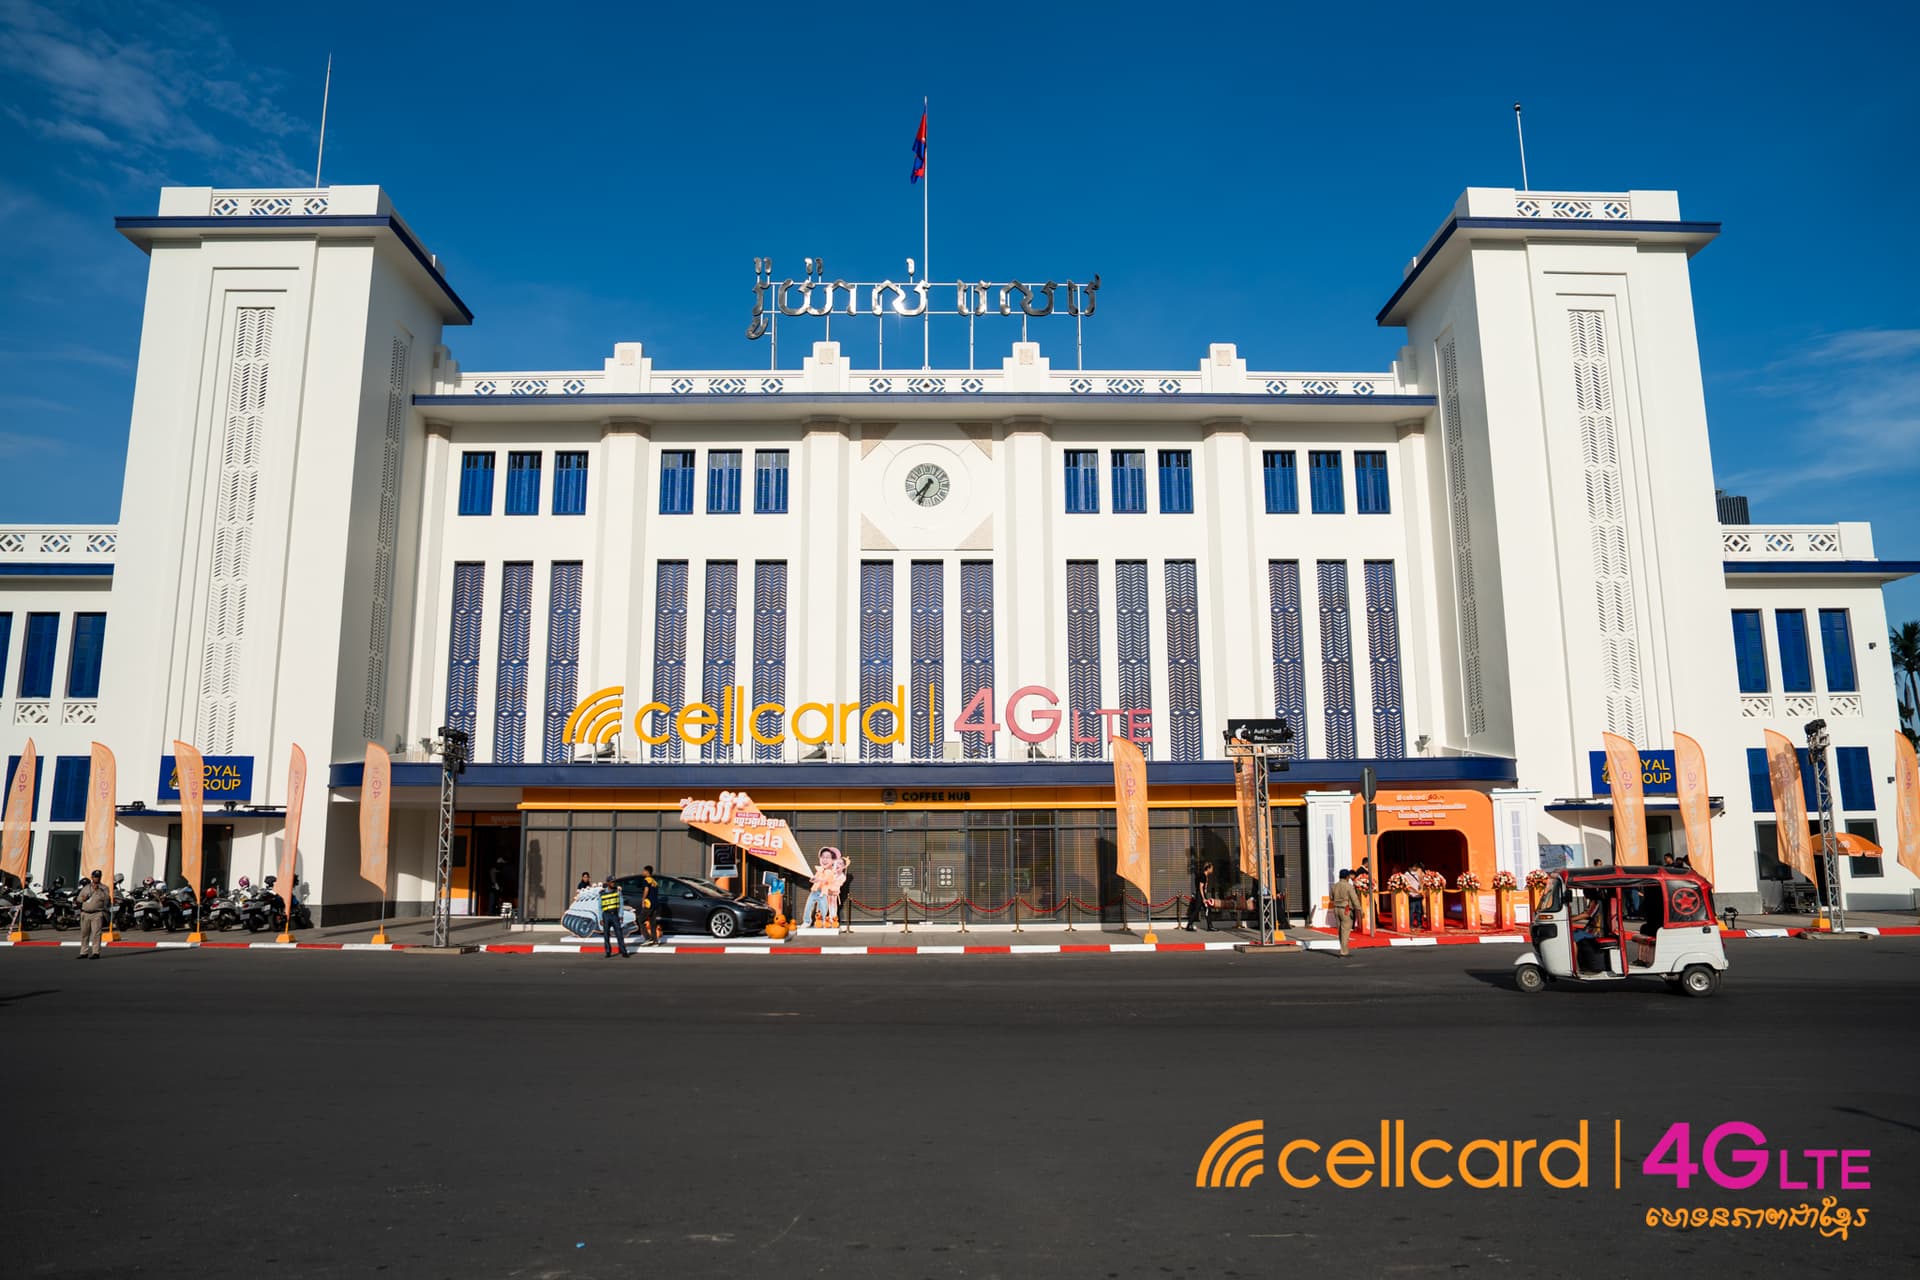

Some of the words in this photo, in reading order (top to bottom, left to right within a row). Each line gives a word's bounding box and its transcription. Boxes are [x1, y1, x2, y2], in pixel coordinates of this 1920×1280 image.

[633, 685, 905, 745] cellcard
[954, 685, 1062, 745] 4G
[1072, 708, 1153, 745] LTE
[203, 765, 241, 777] OYAL
[203, 778, 241, 790] ROUP
[902, 791, 945, 801] COFFEE
[947, 791, 971, 801] HUB
[732, 827, 784, 849] Tesla
